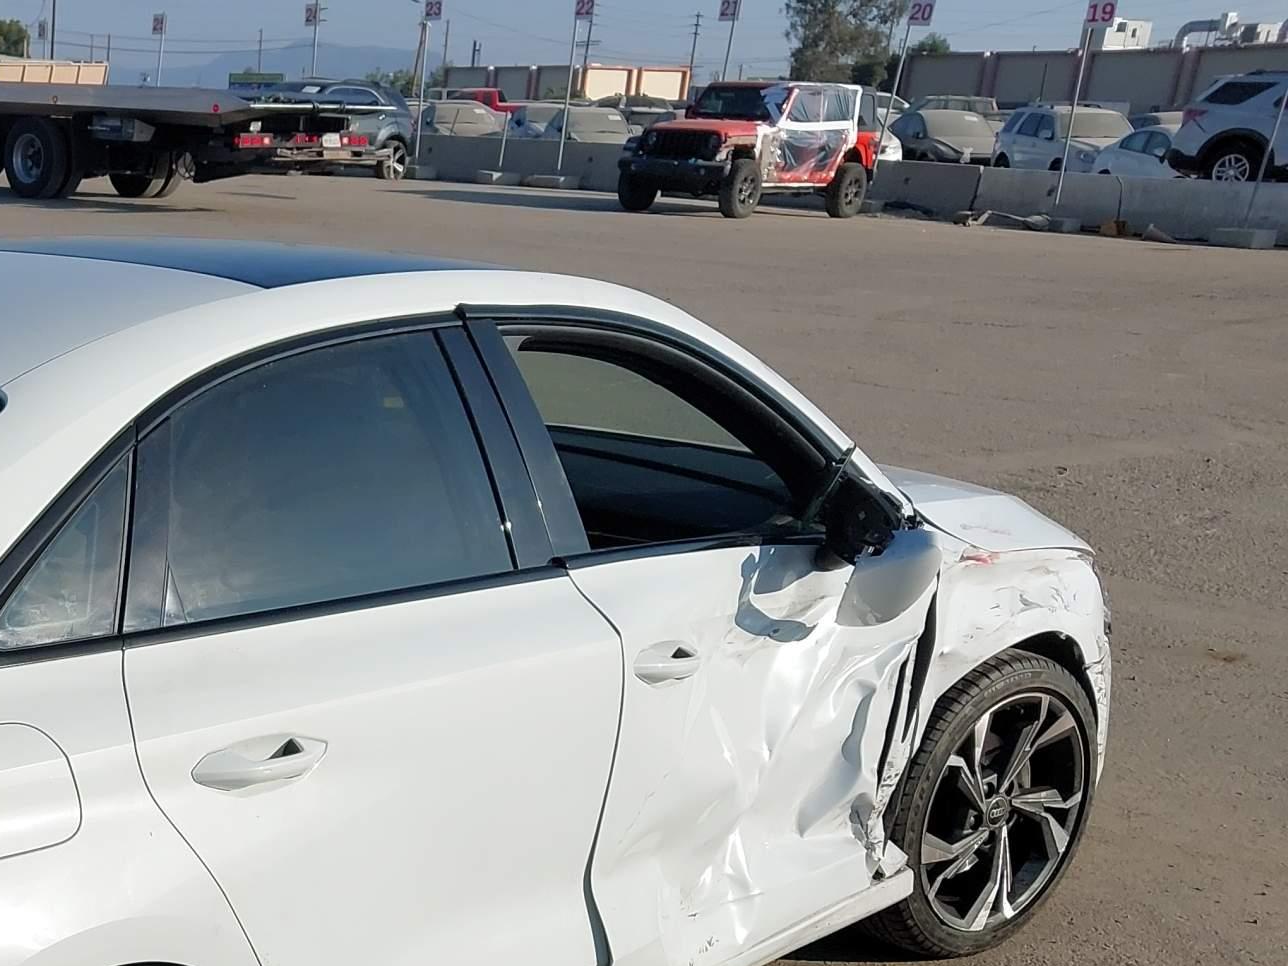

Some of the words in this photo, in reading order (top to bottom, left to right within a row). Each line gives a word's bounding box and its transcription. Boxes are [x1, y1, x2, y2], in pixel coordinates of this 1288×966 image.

[425, 1, 442, 17] 23
[575, 0, 593, 15] 22
[909, 3, 933, 21] 20
[1087, 3, 1115, 22] 19
